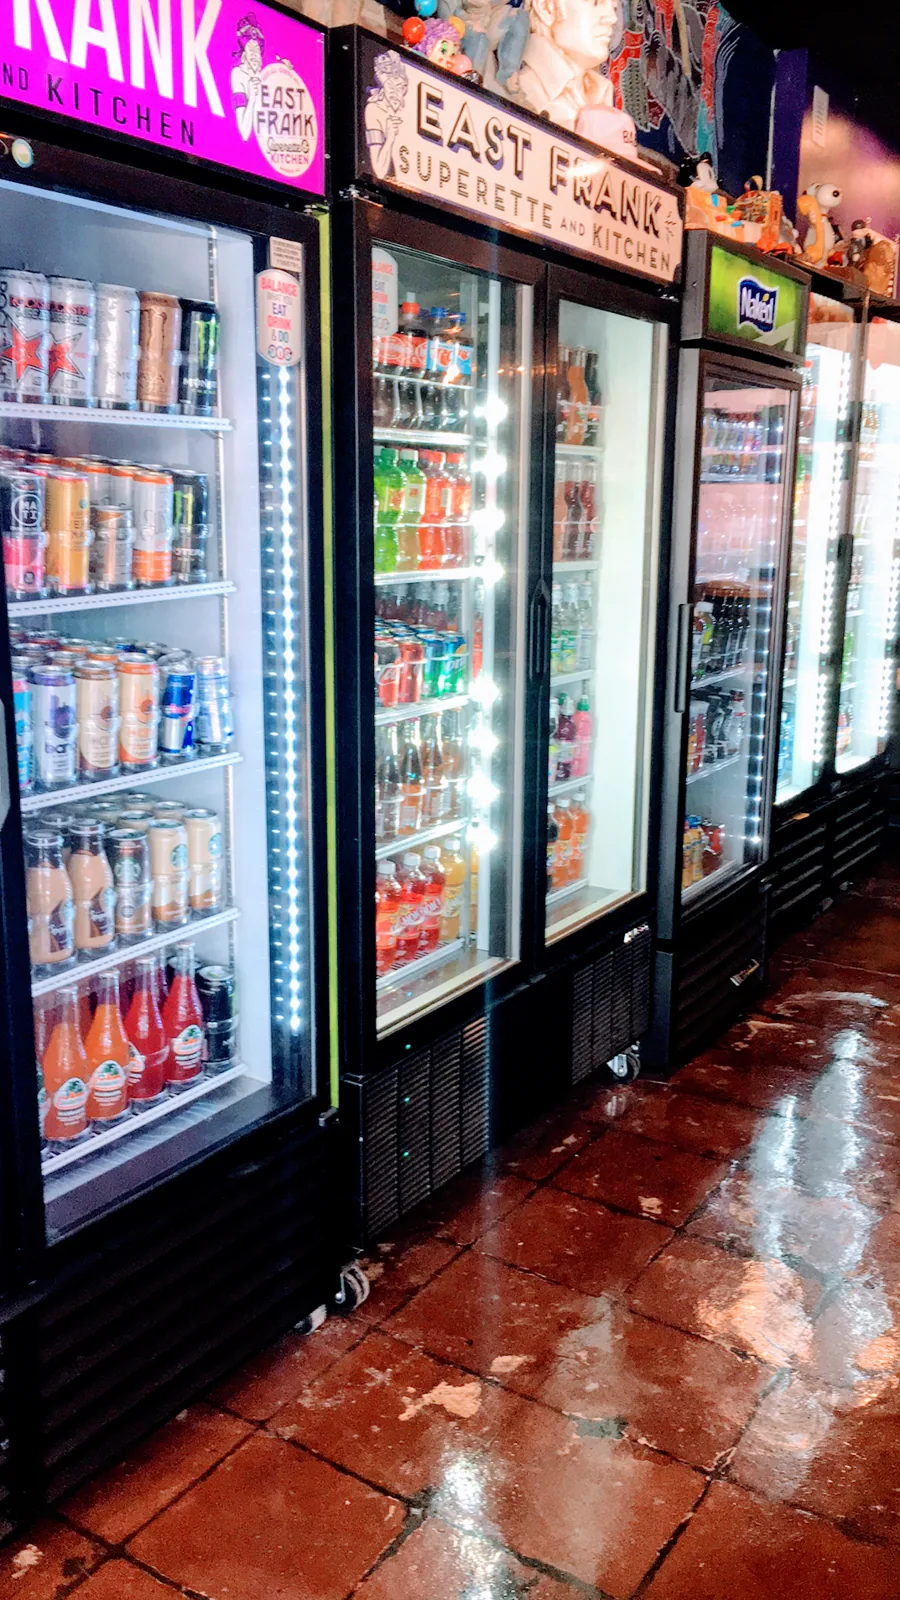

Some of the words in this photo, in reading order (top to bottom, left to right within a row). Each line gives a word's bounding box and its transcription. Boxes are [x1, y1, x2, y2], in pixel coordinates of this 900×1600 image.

[47, 73, 194, 146] KITCHEN
[261, 84, 305, 111] EAST
[256, 111, 314, 136] FRANK
[270, 153, 309, 165] KITCHEN
[417, 81, 532, 181] EAST
[549, 145, 661, 239] FRANK
[399, 145, 552, 229] SUPERETTE
[560, 217, 585, 237] AND
[593, 223, 671, 272] KITCHEN
[260, 276, 298, 297] BALANCE
[272, 303, 287, 317] EAT
[741, 286, 774, 324] Naked
